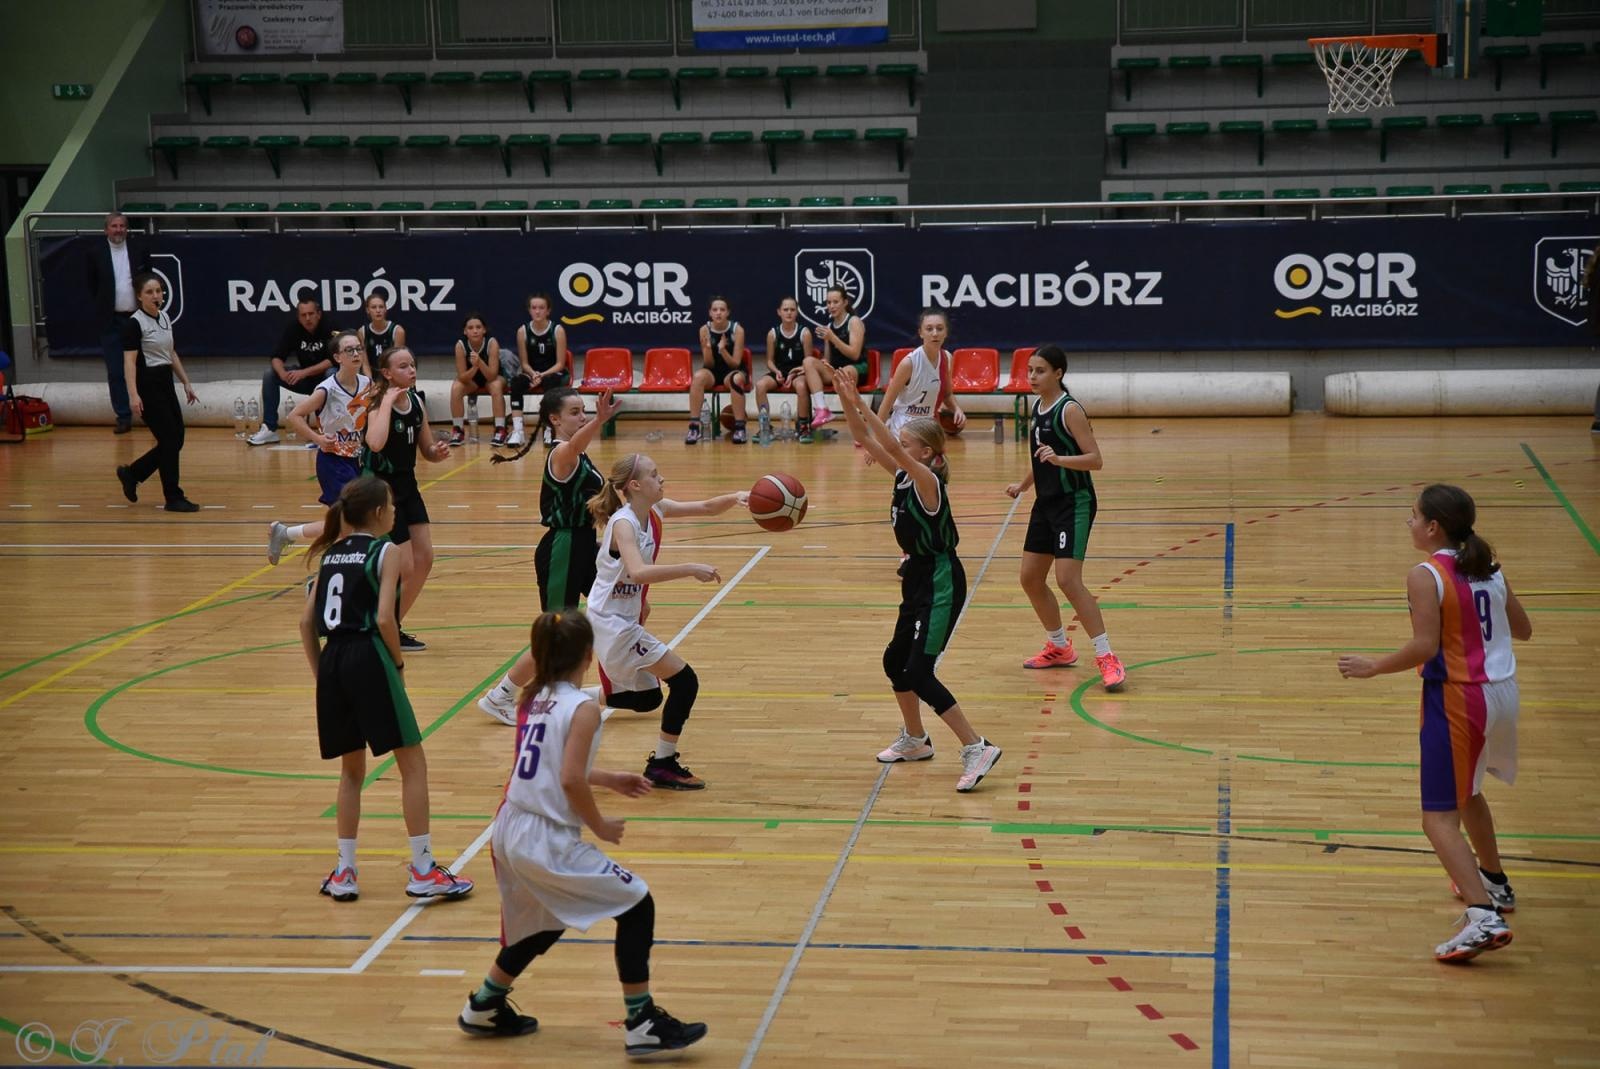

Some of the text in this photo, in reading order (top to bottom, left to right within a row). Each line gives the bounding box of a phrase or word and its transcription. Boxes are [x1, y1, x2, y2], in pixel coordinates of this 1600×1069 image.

[262, 16, 296, 24] Czekamy
[707, 10, 737, 19] 47-400
[814, 6, 866, 16] Eichendorffa
[745, 31, 836, 44] www.instal-tech.pl
[558, 261, 692, 308] OSiR
[921, 260, 1163, 308] RACIBÓRZ
[1273, 252, 1418, 300] OSiR
[227, 266, 457, 313] RACIBÓRZ
[612, 307, 693, 324] RACIBÓRZ
[1330, 300, 1419, 317] RACIBÓRZ
[919, 390, 928, 404] 7
[906, 406, 931, 414] MINI
[407, 426, 415, 444] 11
[1058, 531, 1067, 549] 9
[323, 573, 344, 631] 6
[1474, 589, 1493, 642] 9
